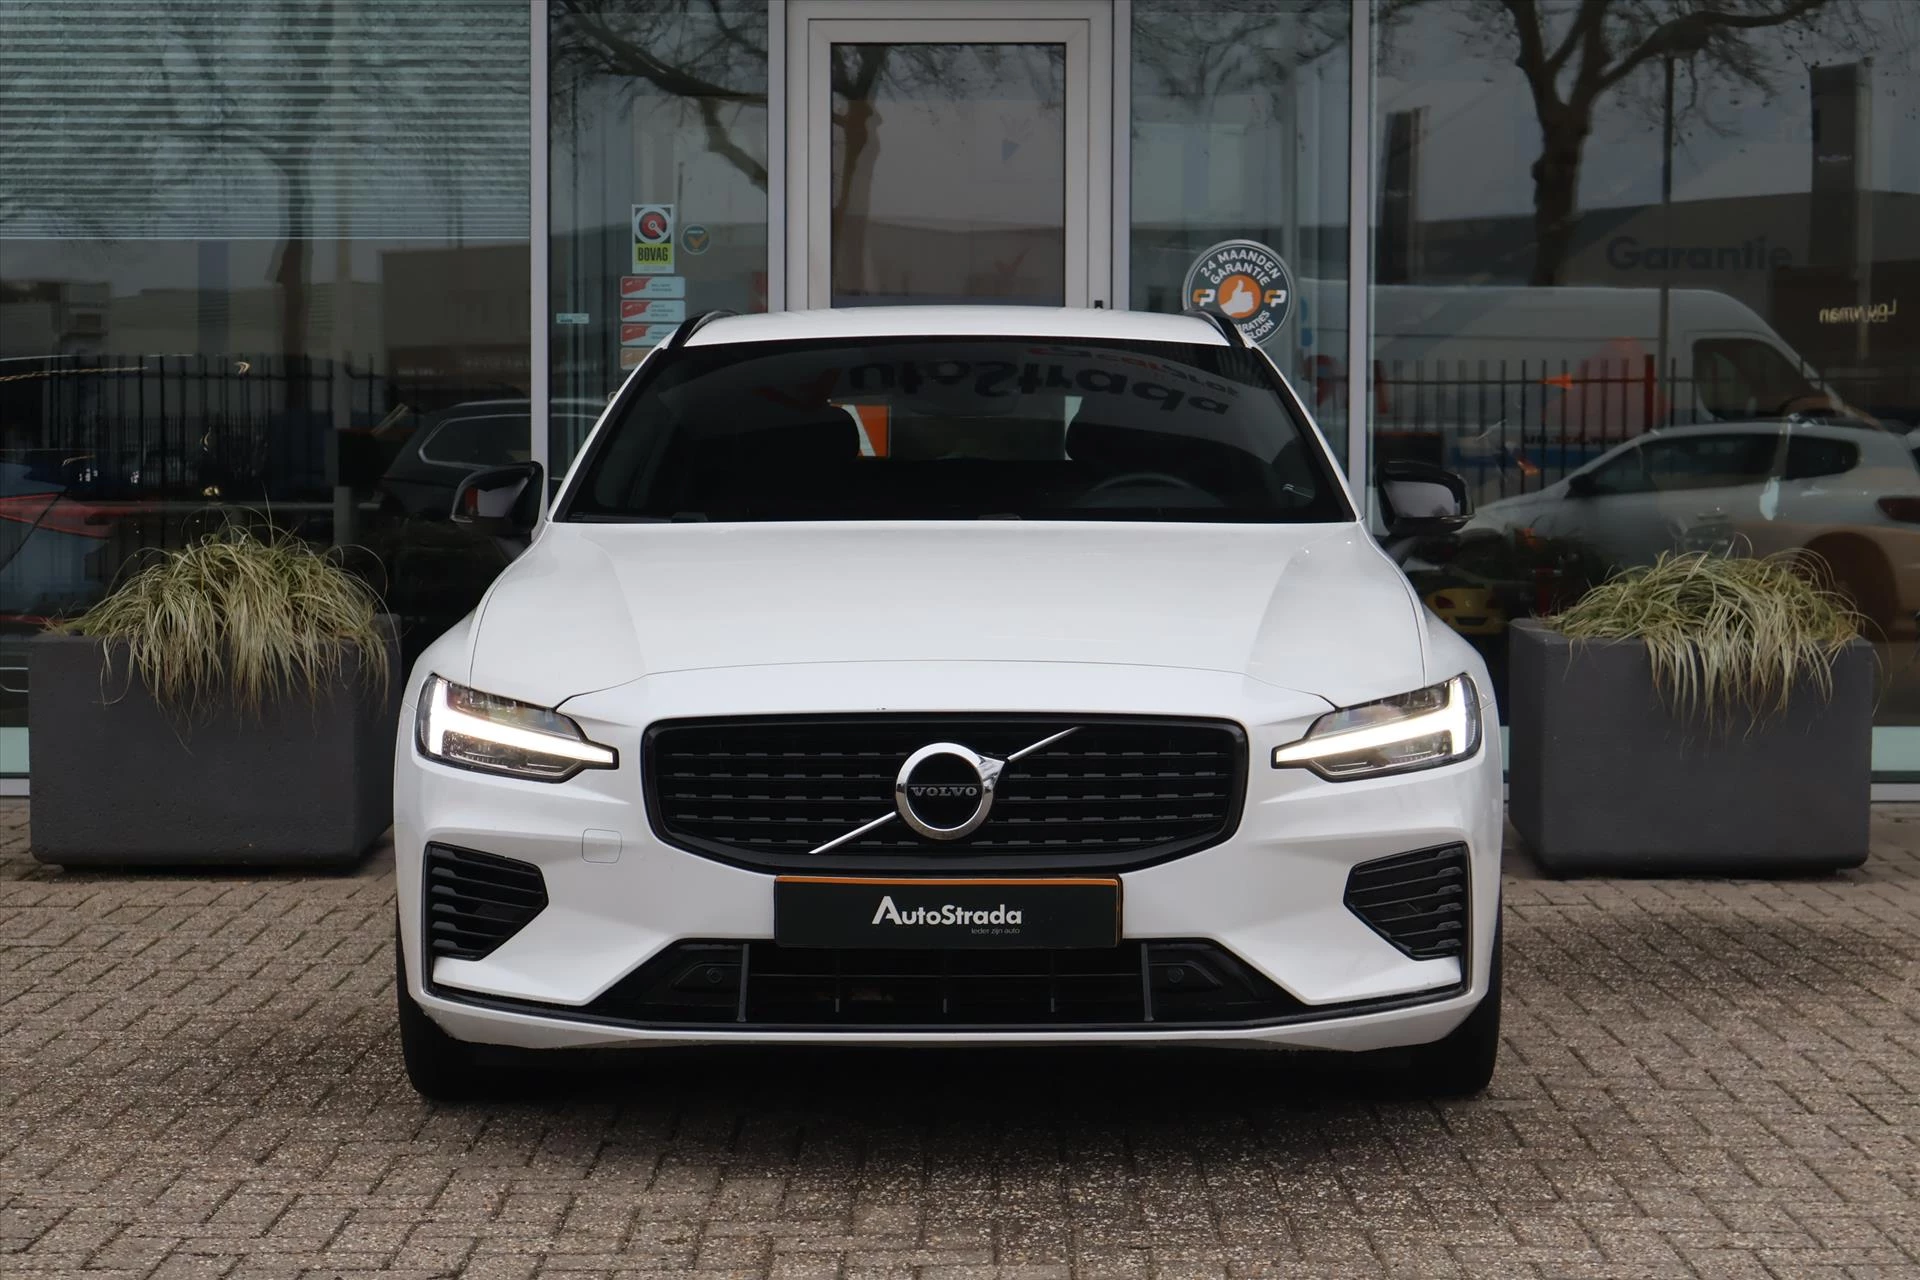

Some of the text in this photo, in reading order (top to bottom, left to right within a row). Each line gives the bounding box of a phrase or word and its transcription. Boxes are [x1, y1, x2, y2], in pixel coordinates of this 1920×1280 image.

[637, 247, 669, 261] BOVAG
[1200, 249, 1281, 279] 24 MAANDEN
[1607, 235, 1794, 271] Garantie
[1210, 262, 1271, 286] GARANTIE
[1238, 310, 1271, 332] RATIES
[910, 786, 978, 797] VOLVO
[871, 896, 1022, 925] AutoStrada
